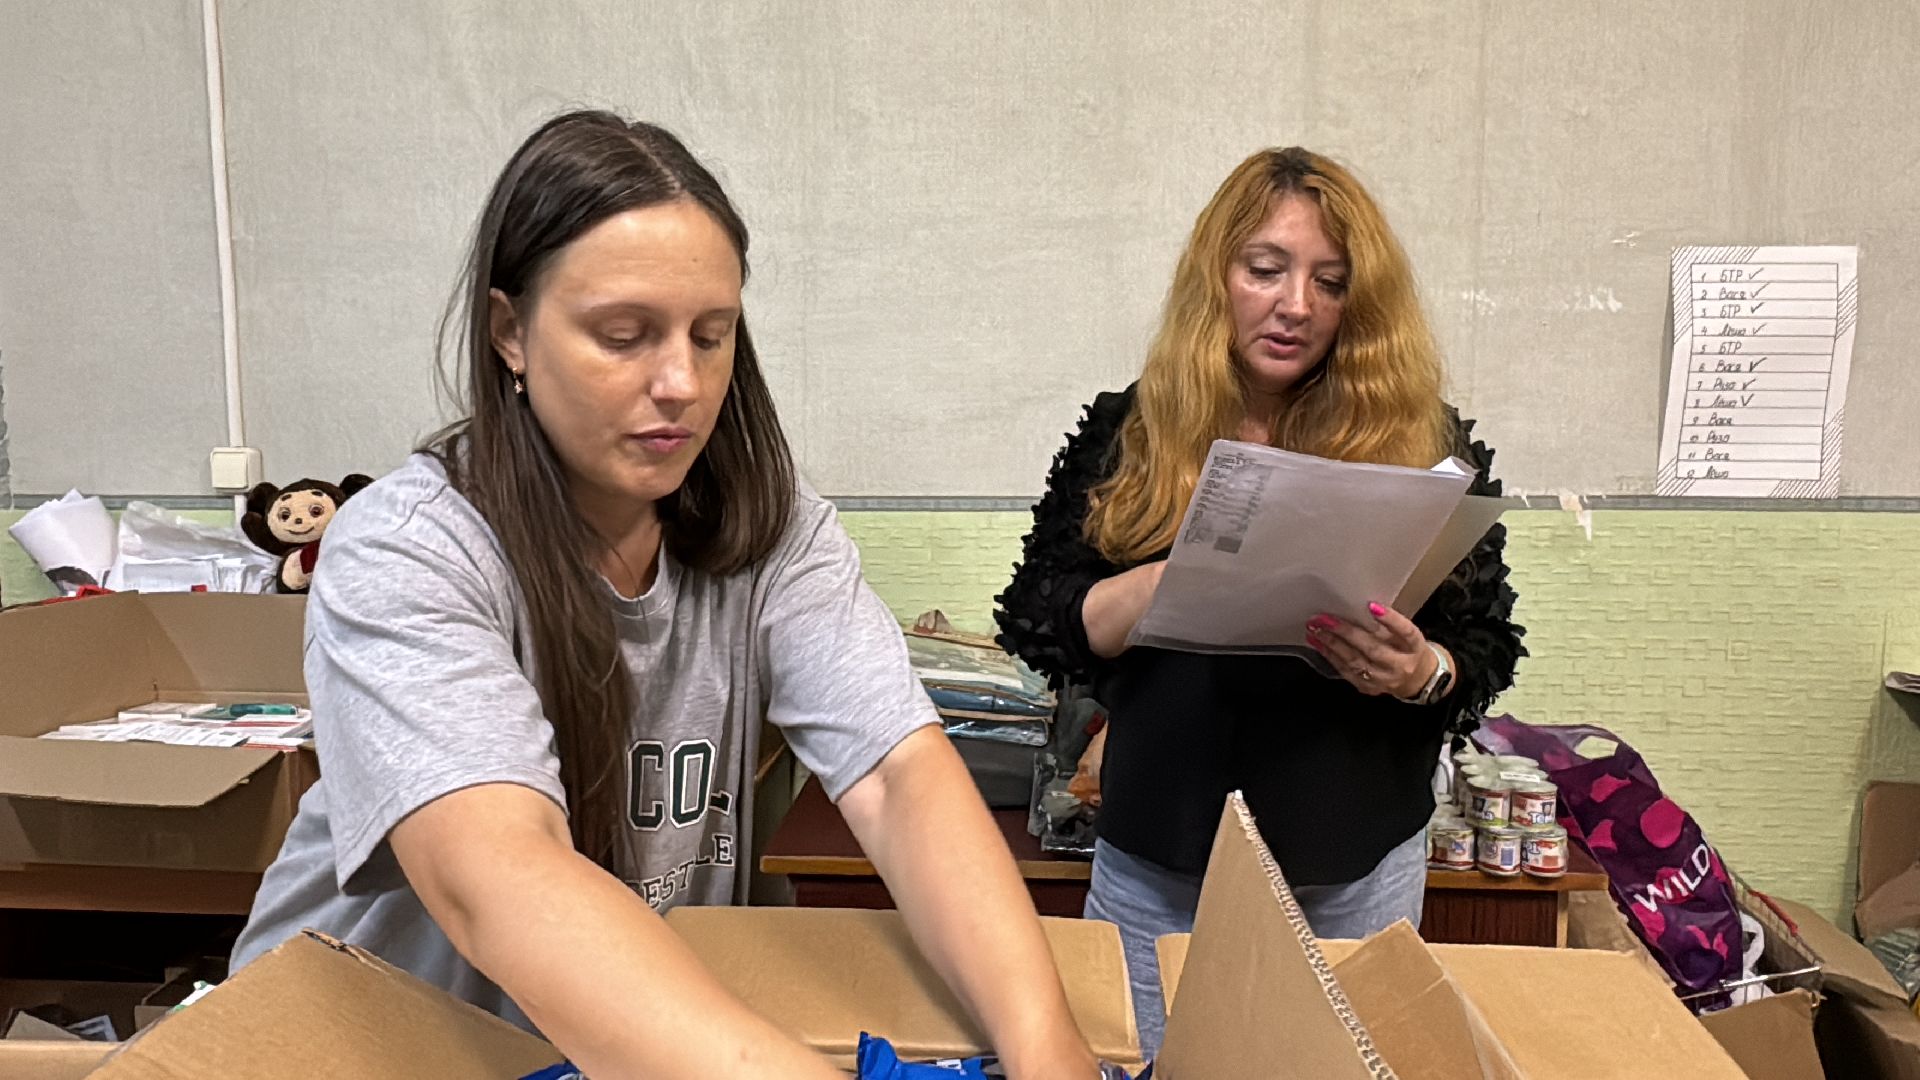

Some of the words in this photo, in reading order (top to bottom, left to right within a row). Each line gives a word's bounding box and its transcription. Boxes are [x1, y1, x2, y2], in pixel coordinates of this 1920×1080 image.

[1720, 269, 1743, 283] БТР
[1720, 304, 1741, 318] БТР
[1719, 341, 1742, 354] БТР
[1633, 844, 1710, 912] WILD
